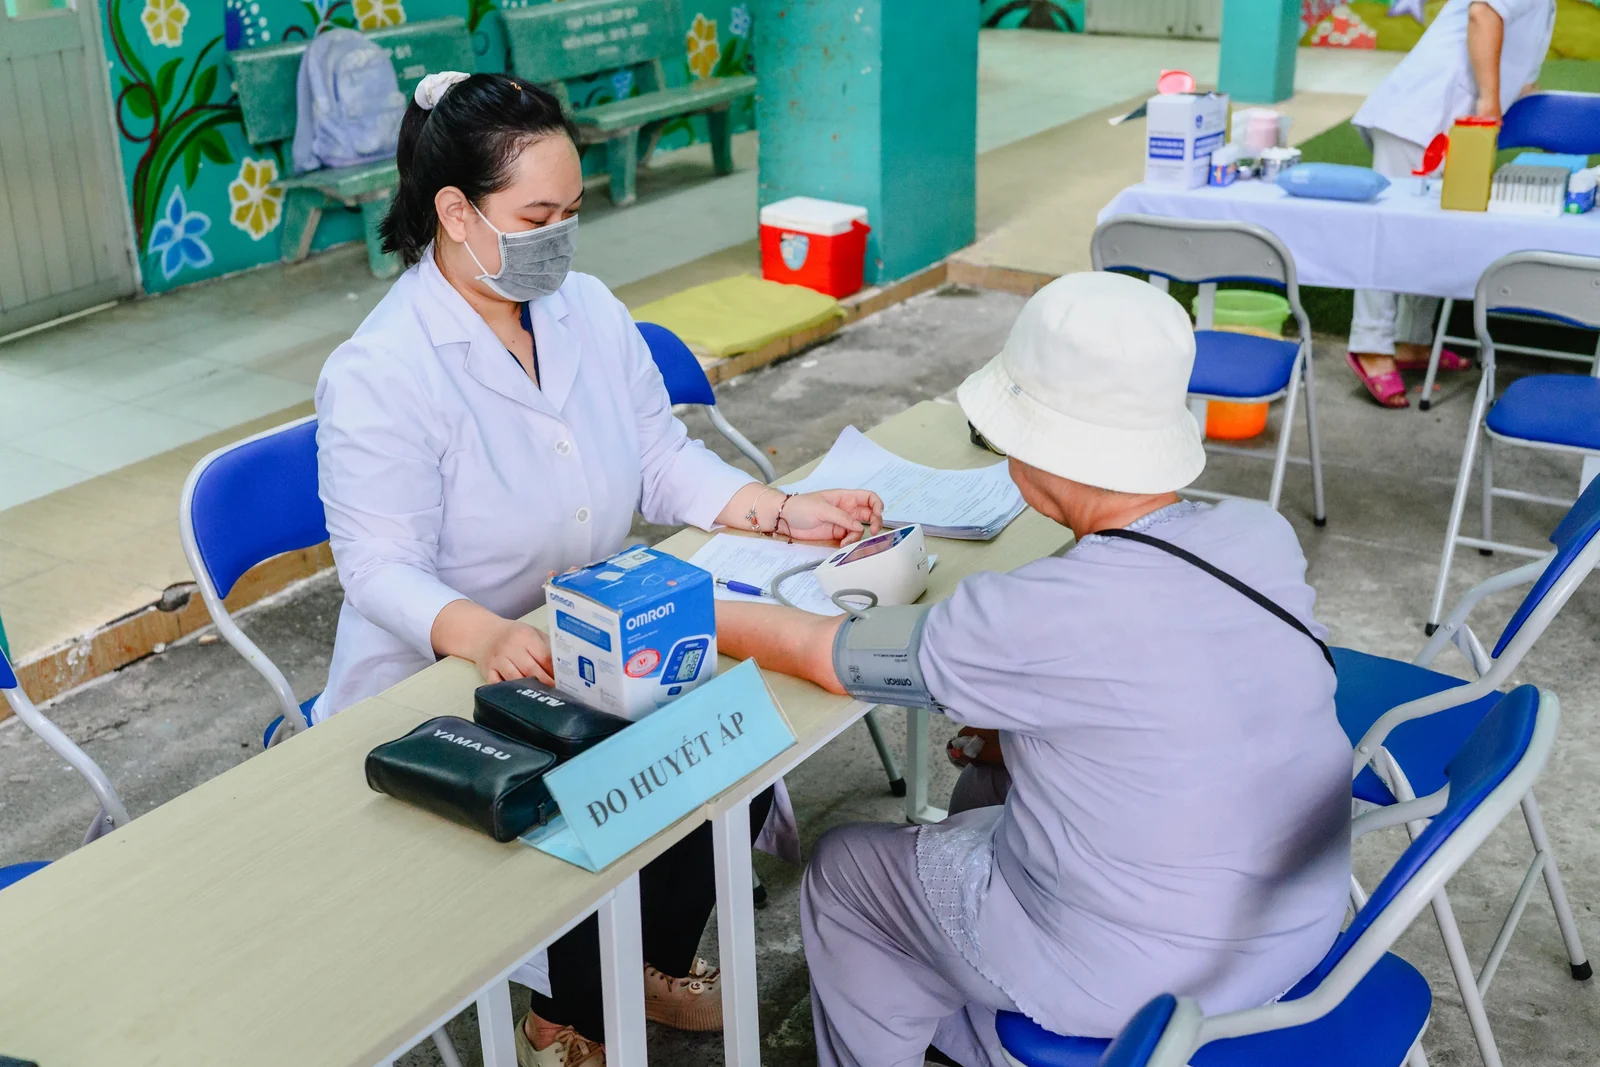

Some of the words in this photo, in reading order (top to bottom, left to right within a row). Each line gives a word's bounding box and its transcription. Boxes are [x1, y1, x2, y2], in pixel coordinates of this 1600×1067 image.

[549, 592, 575, 609] OMRON
[626, 602, 675, 631] OMRON
[884, 677, 912, 687] OMRON
[433, 729, 512, 760] YAMASU
[586, 788, 628, 828] ĐO
[628, 730, 714, 801] HUYẾT
[717, 711, 745, 747] ÁP
